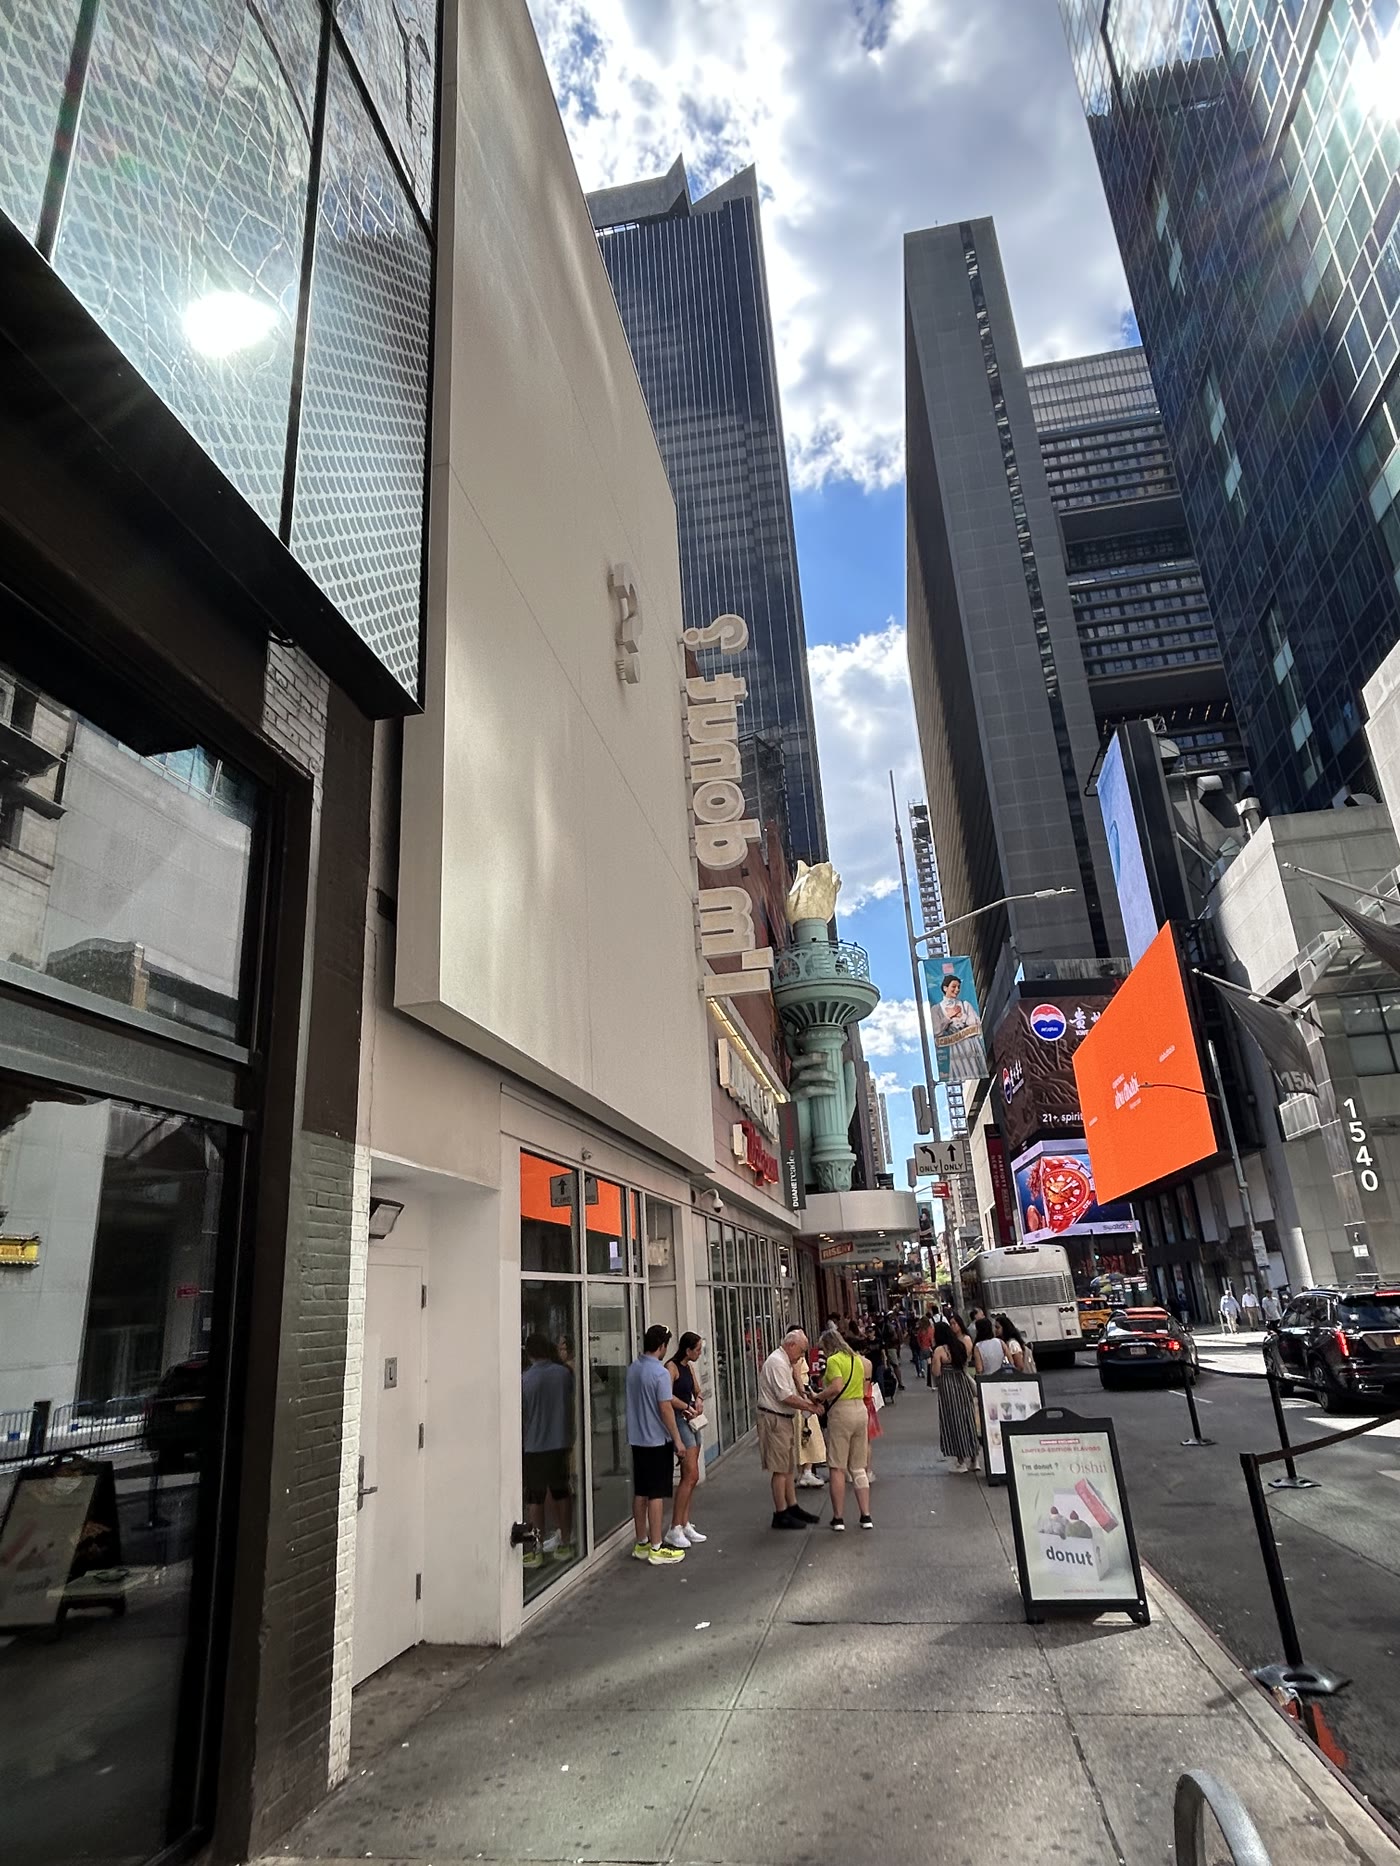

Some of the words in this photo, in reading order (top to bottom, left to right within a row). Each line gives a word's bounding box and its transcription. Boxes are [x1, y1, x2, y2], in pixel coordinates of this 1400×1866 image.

[1343, 1098, 1379, 1192] 1540
[919, 1164, 939, 1173] ONLY
[943, 1162, 964, 1171] ONLY
[1021, 1463, 1032, 1471] I'm
[1033, 1463, 1053, 1471] donut
[1069, 1461, 1108, 1475] Oishii
[1046, 1545, 1094, 1567] donut
